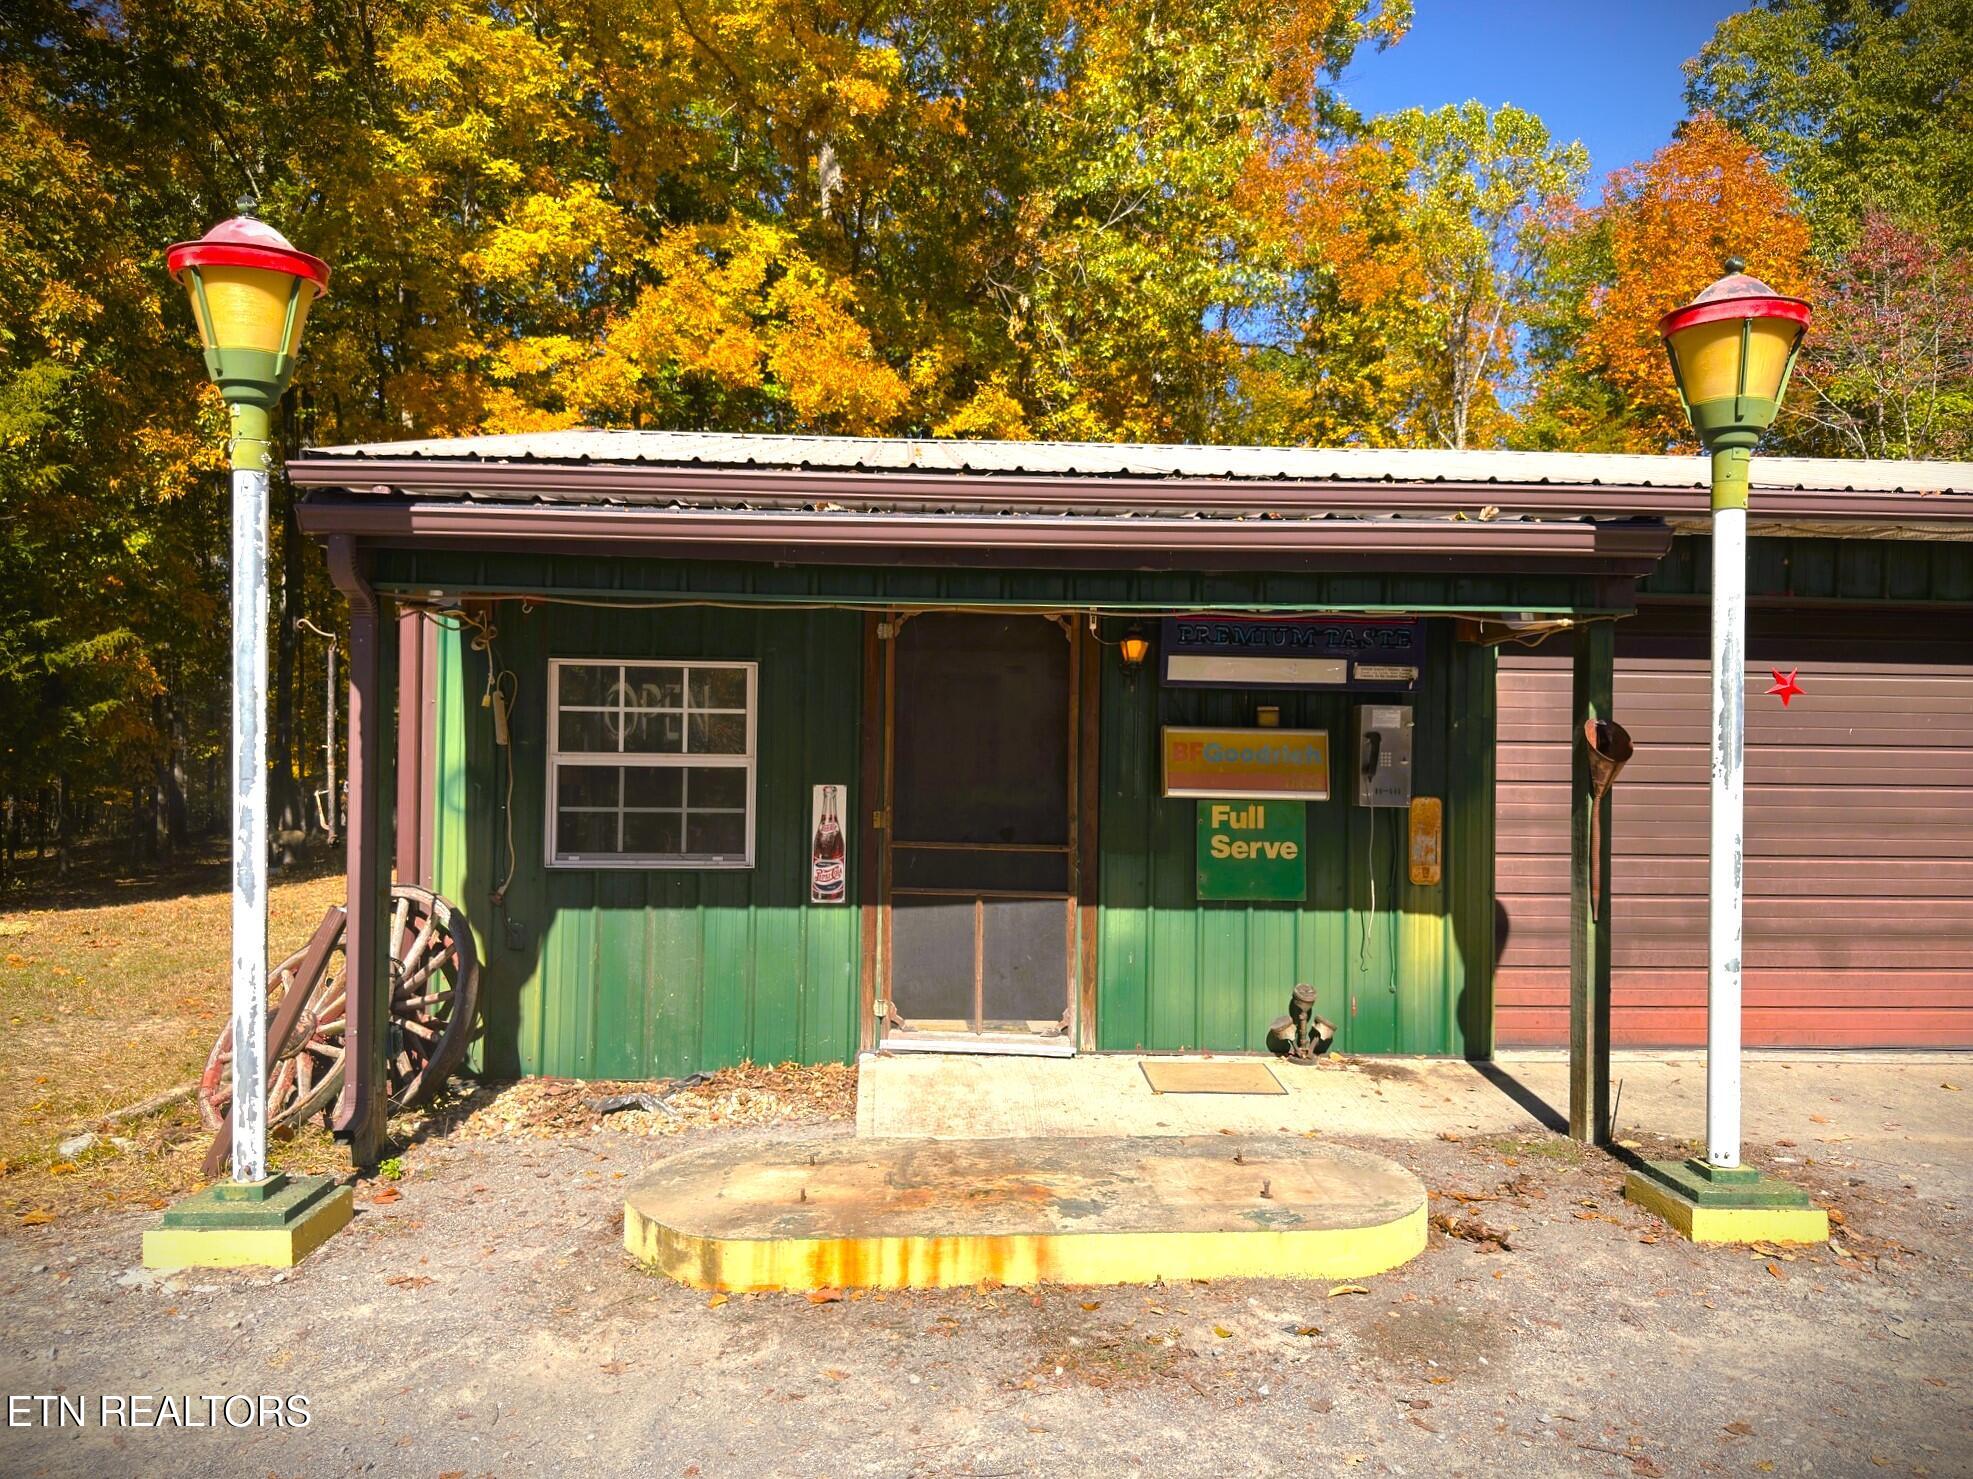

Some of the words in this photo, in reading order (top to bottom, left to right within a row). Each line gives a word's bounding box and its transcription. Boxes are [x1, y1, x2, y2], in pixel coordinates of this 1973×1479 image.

[1177, 624, 1317, 647] PREMIUM
[1325, 627, 1413, 649] TASTE
[604, 682, 711, 742] OPEN
[1173, 742, 1323, 766] BFGoodrich
[1211, 805, 1264, 829] Full
[1211, 834, 1298, 860] Serve
